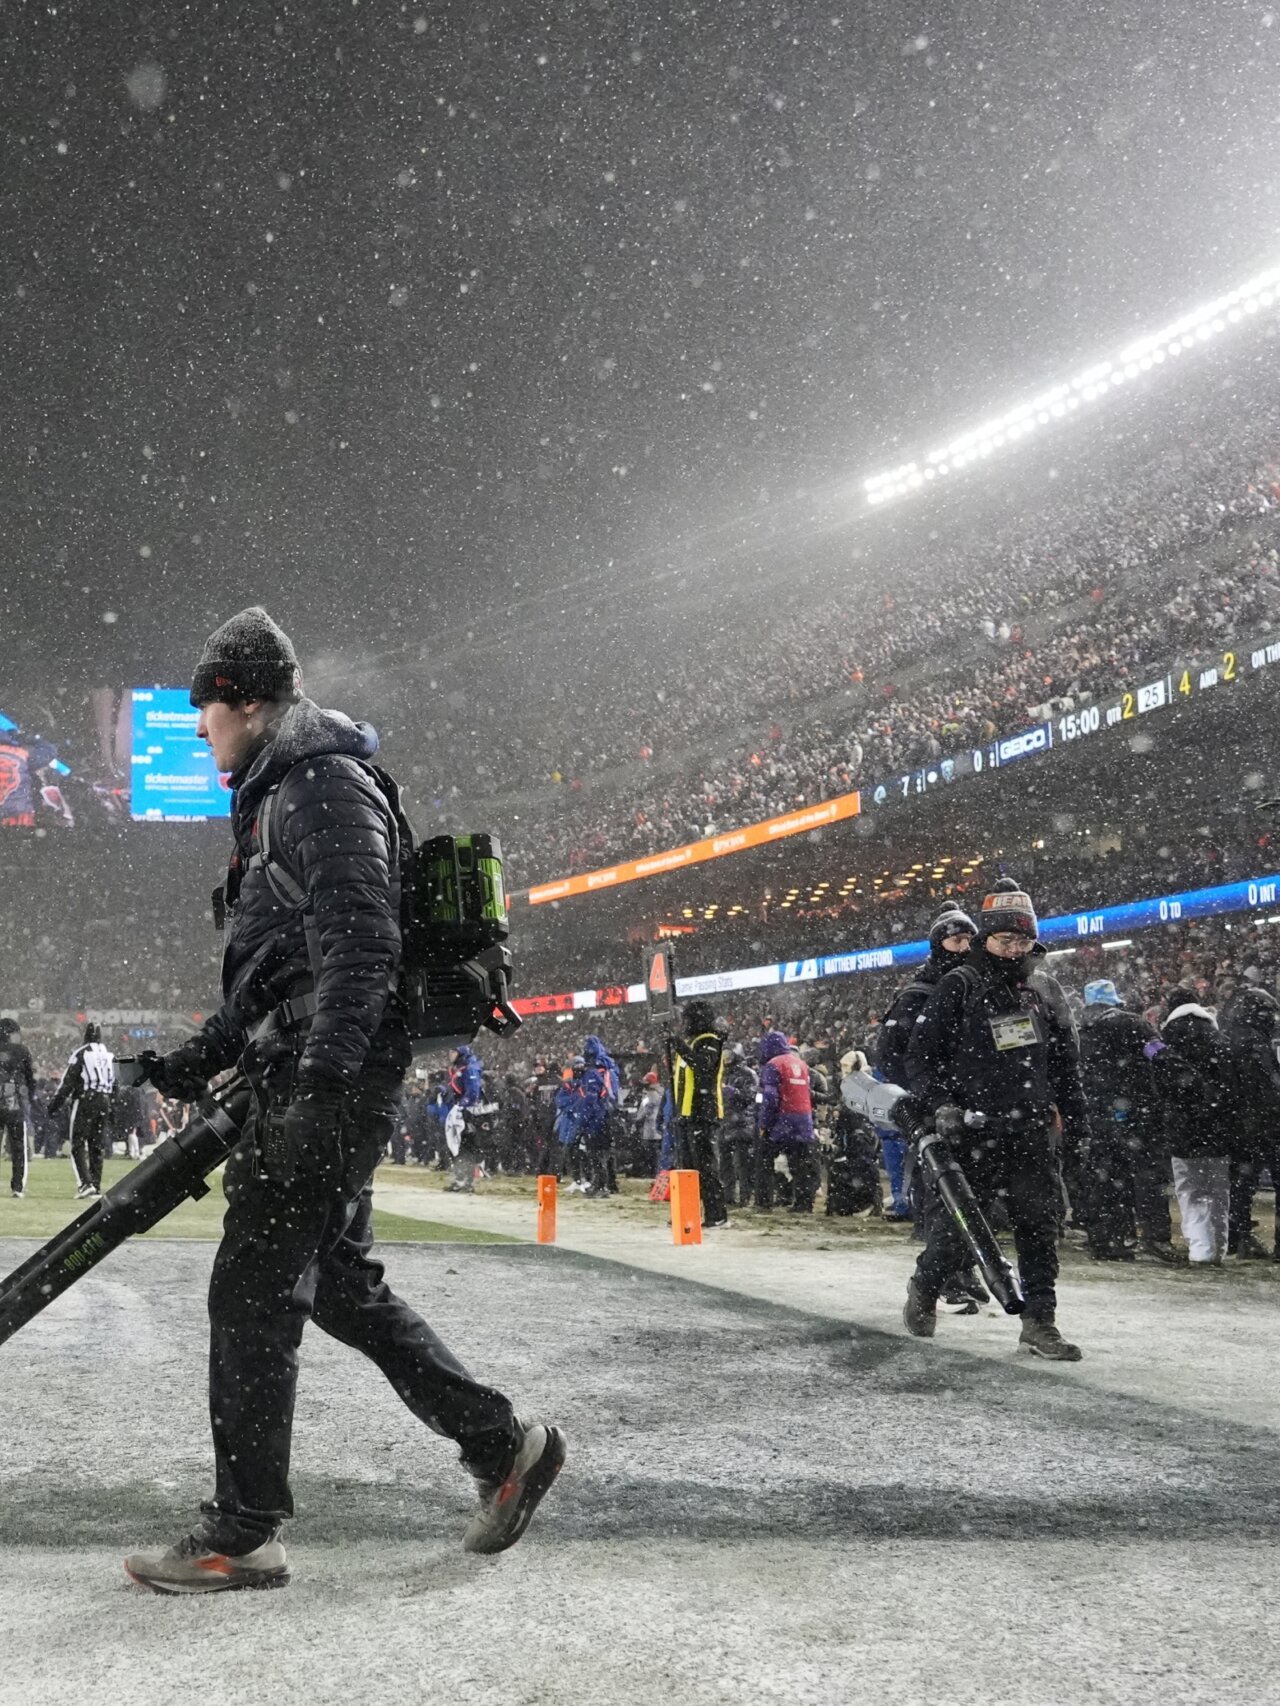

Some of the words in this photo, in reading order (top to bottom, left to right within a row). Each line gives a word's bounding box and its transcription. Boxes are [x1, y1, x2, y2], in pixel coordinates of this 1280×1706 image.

[1179, 670, 1191, 695] 4
[1200, 668, 1218, 690] AND
[1223, 652, 1236, 680] 2
[1251, 649, 1265, 669] ON
[1059, 706, 1099, 741] 15:00
[1122, 693, 1134, 719] 2
[1144, 687, 1159, 707] 25
[1000, 729, 1046, 760] GEICO
[973, 750, 982, 772] 0
[144, 772, 209, 785] ticketmaster
[901, 776, 910, 796] 7
[1076, 915, 1088, 935] 10
[1089, 916, 1104, 933] ATT
[1159, 901, 1168, 921] 0
[1170, 902, 1181, 918] TD
[1248, 884, 1257, 905] 0
[1259, 883, 1276, 903] INT
[649, 952, 667, 992] 4
[824, 955, 857, 975] MATTHEW
[857, 949, 893, 971] STAFFORD
